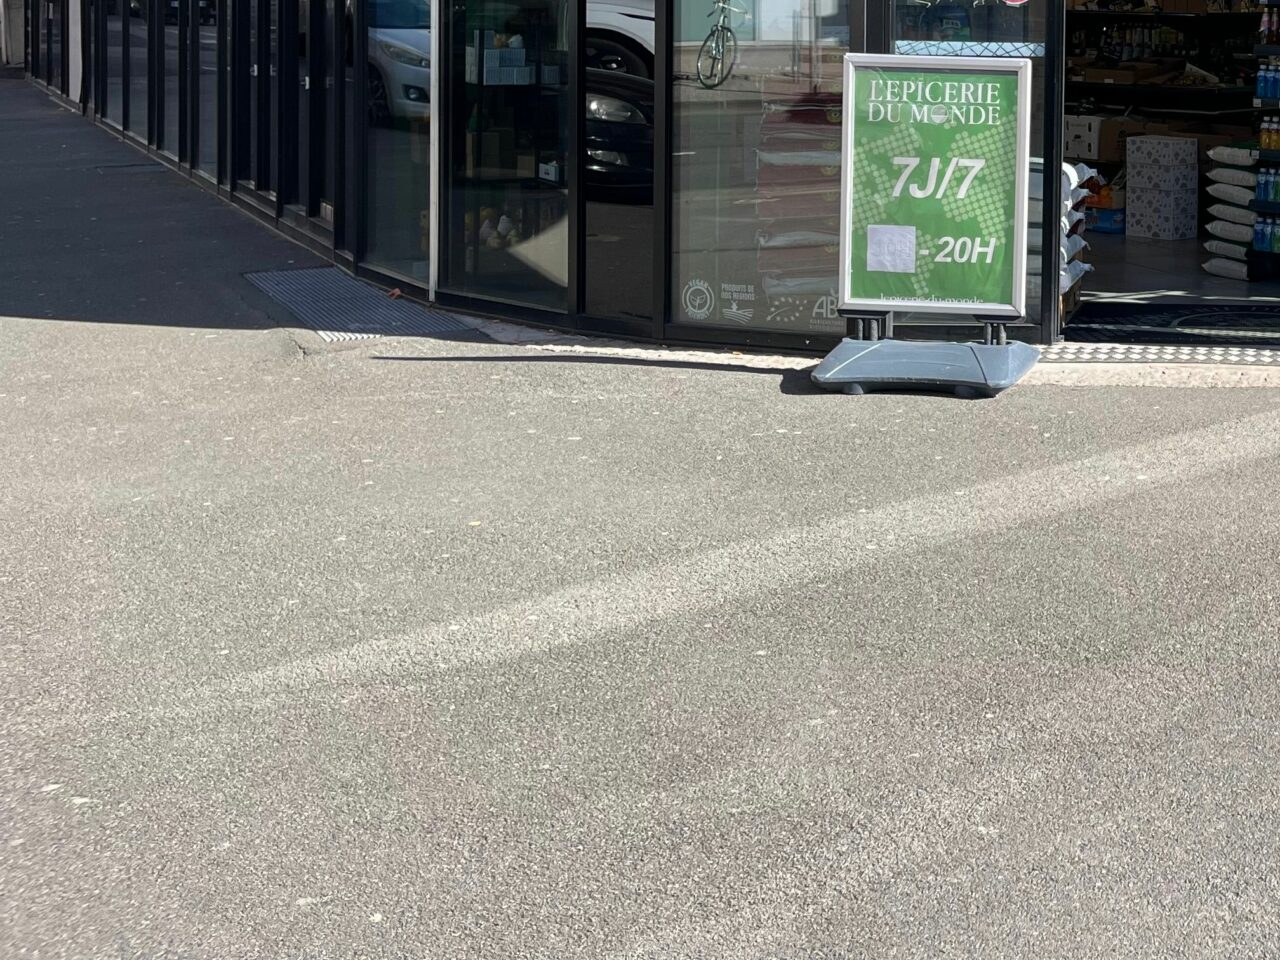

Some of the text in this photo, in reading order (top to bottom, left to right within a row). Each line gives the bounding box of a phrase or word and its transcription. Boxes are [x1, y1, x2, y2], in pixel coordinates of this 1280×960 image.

[869, 79, 1001, 104] L'EPICERIE
[868, 102, 1001, 126] DU MONDE
[891, 156, 986, 199] 7J/7
[934, 236, 997, 264] 20H
